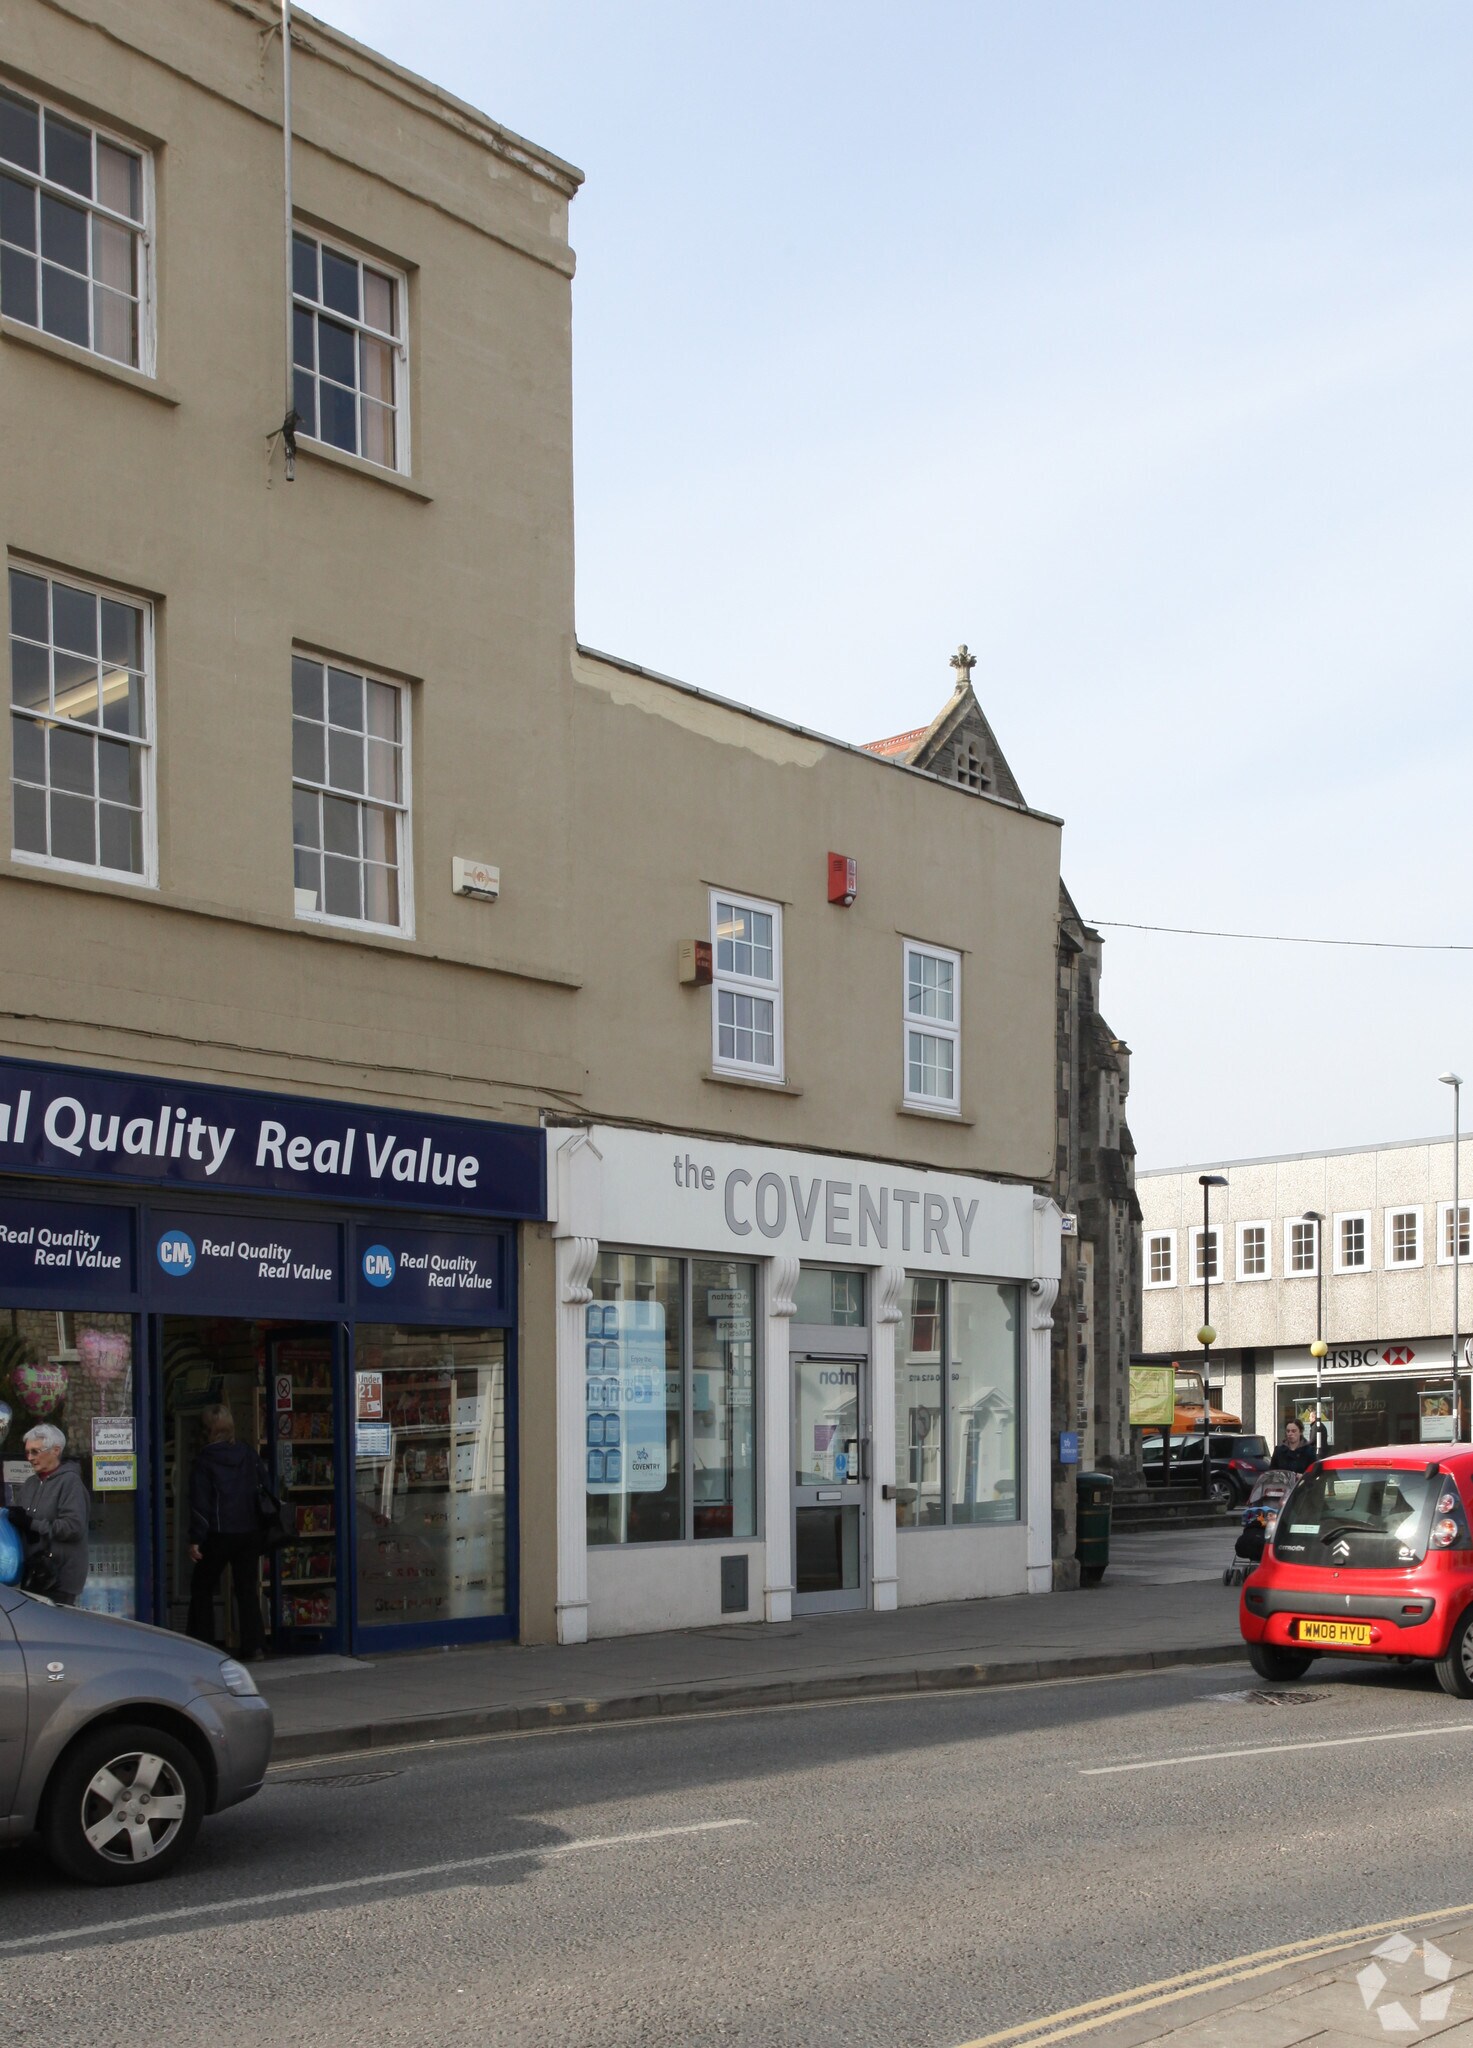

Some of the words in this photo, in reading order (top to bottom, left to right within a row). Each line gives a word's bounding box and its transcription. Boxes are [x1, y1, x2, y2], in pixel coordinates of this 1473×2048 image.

[44, 1096, 235, 1175] Quality
[255, 1121, 355, 1175] Real
[366, 1133, 480, 1189] Value
[673, 1154, 715, 1190] the
[724, 1168, 980, 1257] COVENTRY
[0, 1225, 34, 1244] Real
[38, 1228, 100, 1251] Quality
[34, 1249, 72, 1266] Real
[76, 1250, 122, 1268] Value
[201, 1239, 235, 1257] Real
[238, 1242, 292, 1263] Quality
[258, 1262, 290, 1278] Real
[293, 1263, 332, 1280] Value
[400, 1252, 428, 1269] Real
[431, 1255, 477, 1275] Quality
[428, 1272, 456, 1287] Real
[458, 1273, 493, 1289] Value
[1322, 1348, 1379, 1369] HSBC
[358, 1374, 380, 1384] Under
[358, 1384, 373, 1398] 21
[1305, 1622, 1336, 1639] WM08
[1340, 1626, 1365, 1641] HYU
